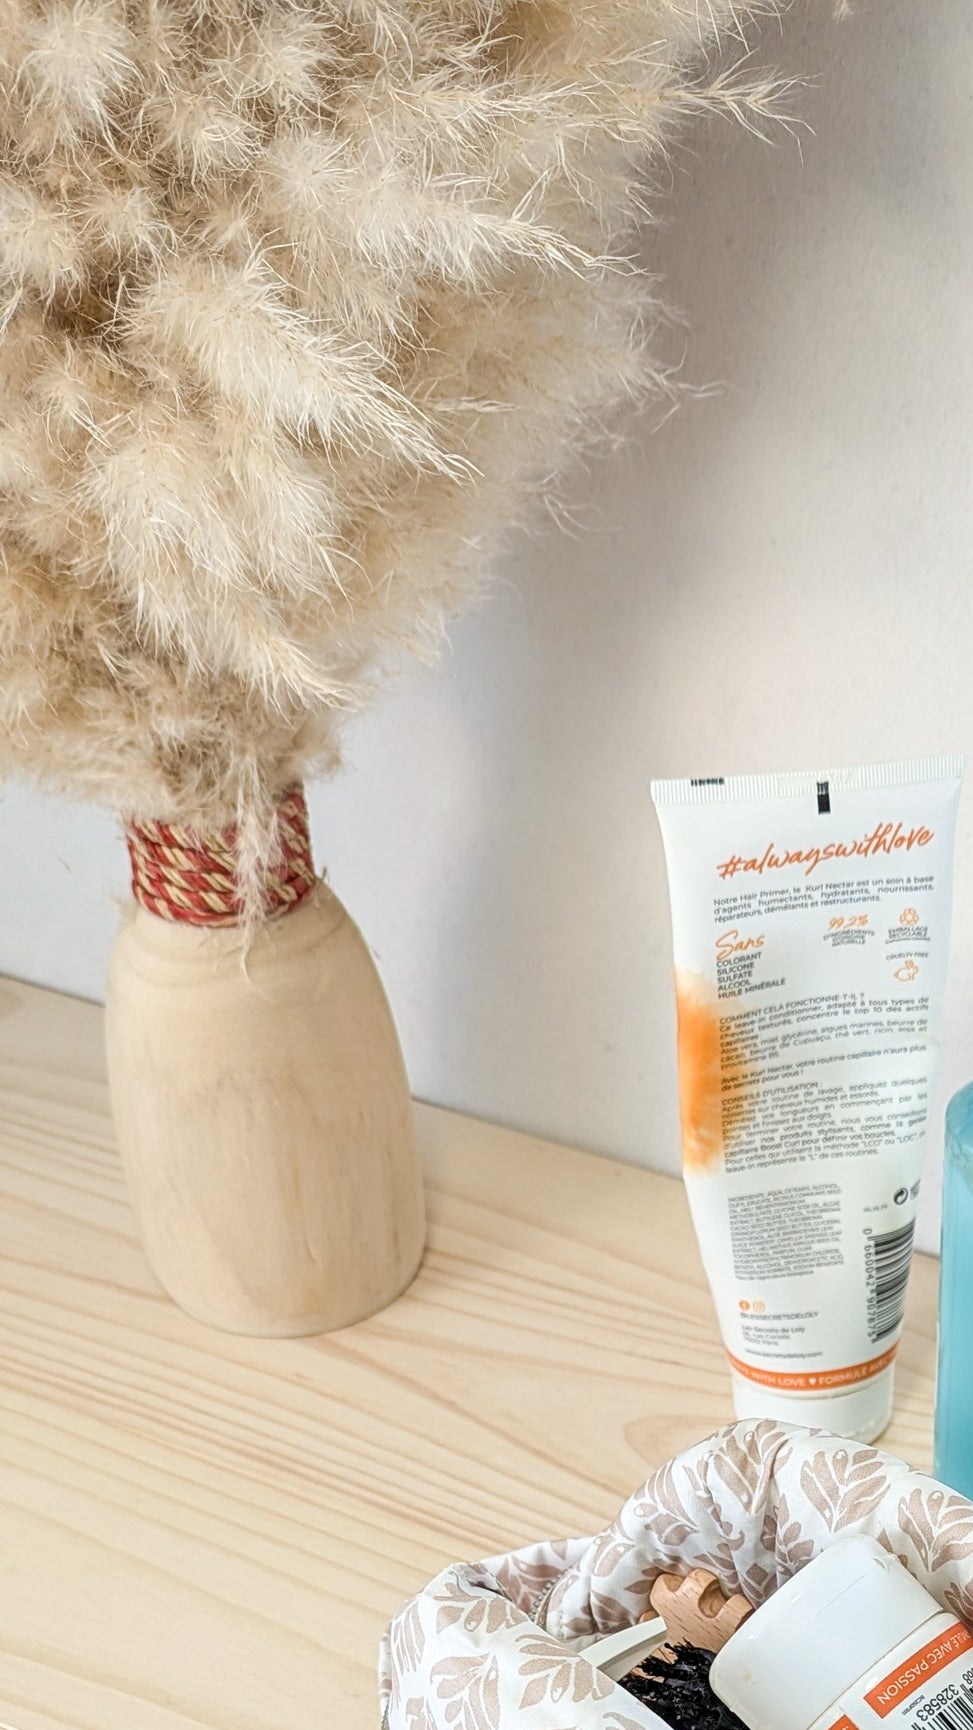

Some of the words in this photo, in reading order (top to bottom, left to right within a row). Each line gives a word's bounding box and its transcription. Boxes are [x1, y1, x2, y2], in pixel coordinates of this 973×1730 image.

[713, 897, 738, 907] Notre
[740, 893, 757, 902] Hair
[805, 883, 824, 892] Kurl
[825, 881, 854, 890] Nectar
[856, 879, 869, 887] est
[885, 877, 904, 885] soin
[914, 875, 934, 883] base
[820, 887, 871, 899] hydratants,
[810, 899, 819, 907] et
[715, 929, 765, 961] Sans
[716, 951, 762, 968] COLORANT
[716, 961, 755, 976] SILICONE
[717, 970, 753, 984] SULFATE
[717, 979, 751, 992] ALCOOL
[718, 988, 742, 1000] HUILE
[763, 1003, 784, 1015] CELA
[826, 1001, 857, 1011] adapté
[869, 999, 888, 1007] tous
[891, 997, 915, 1006] types
[918, 996, 929, 1004] de
[842, 1007, 851, 1016] le
[854, 1006, 870, 1016] top
[873, 1006, 883, 1014] 10
[886, 1005, 902, 1013] des
[905, 1003, 929, 1012] actifs
[926, 1643, 953, 1665] AVEC
[876, 1660, 931, 1706] PASSION
[915, 1684, 960, 1722] 328583
